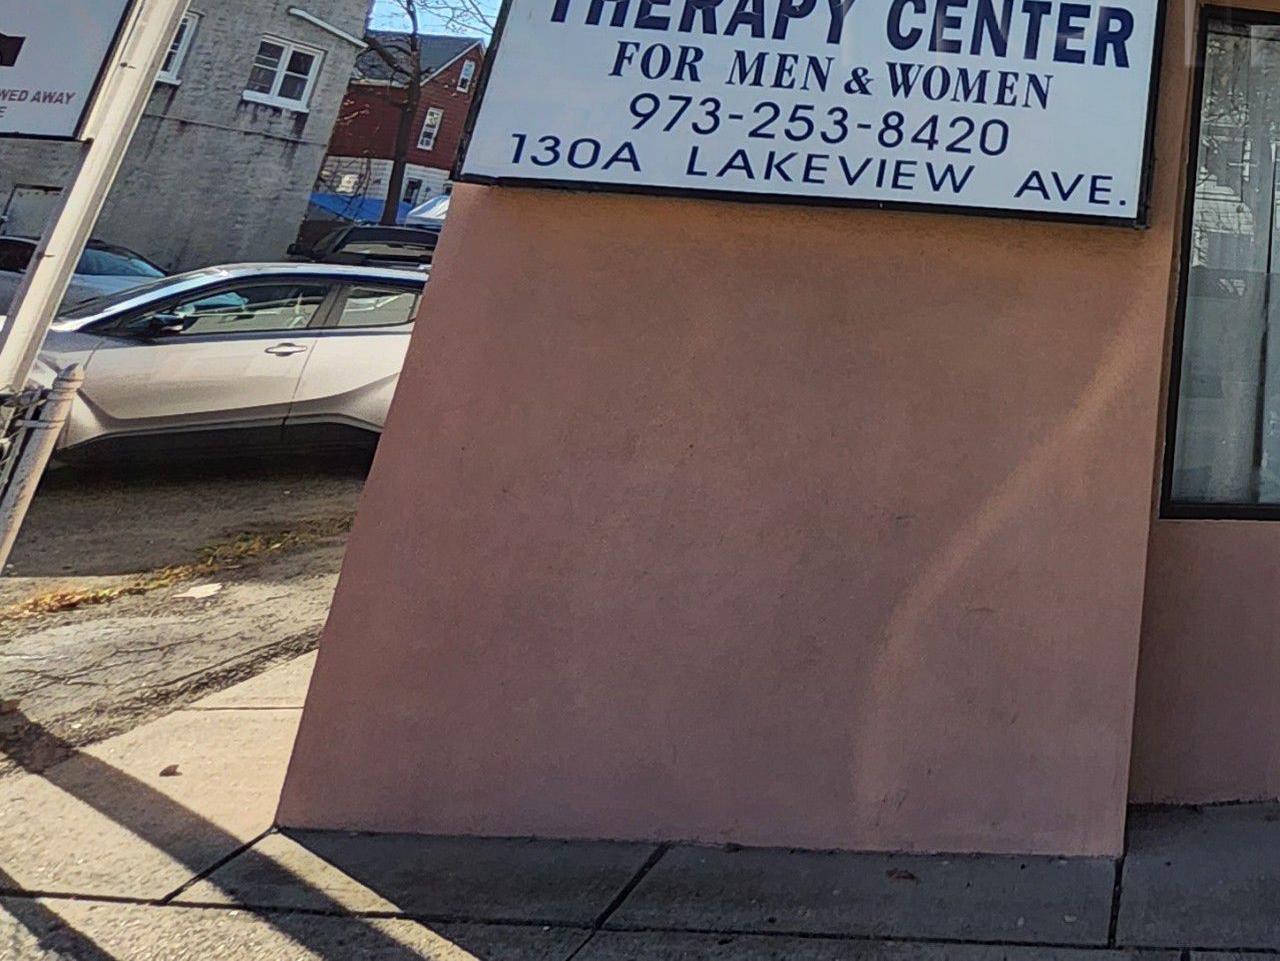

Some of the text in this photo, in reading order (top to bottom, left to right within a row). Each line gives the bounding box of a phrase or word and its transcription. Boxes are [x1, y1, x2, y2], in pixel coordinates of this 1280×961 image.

[30, 90, 76, 105] AWAY
[607, 40, 1054, 110] FOR MEN & WOMEN
[629, 92, 1010, 158] 973-253-8420
[510, 133, 1129, 207] 130A LAKEVIEW AVE.
